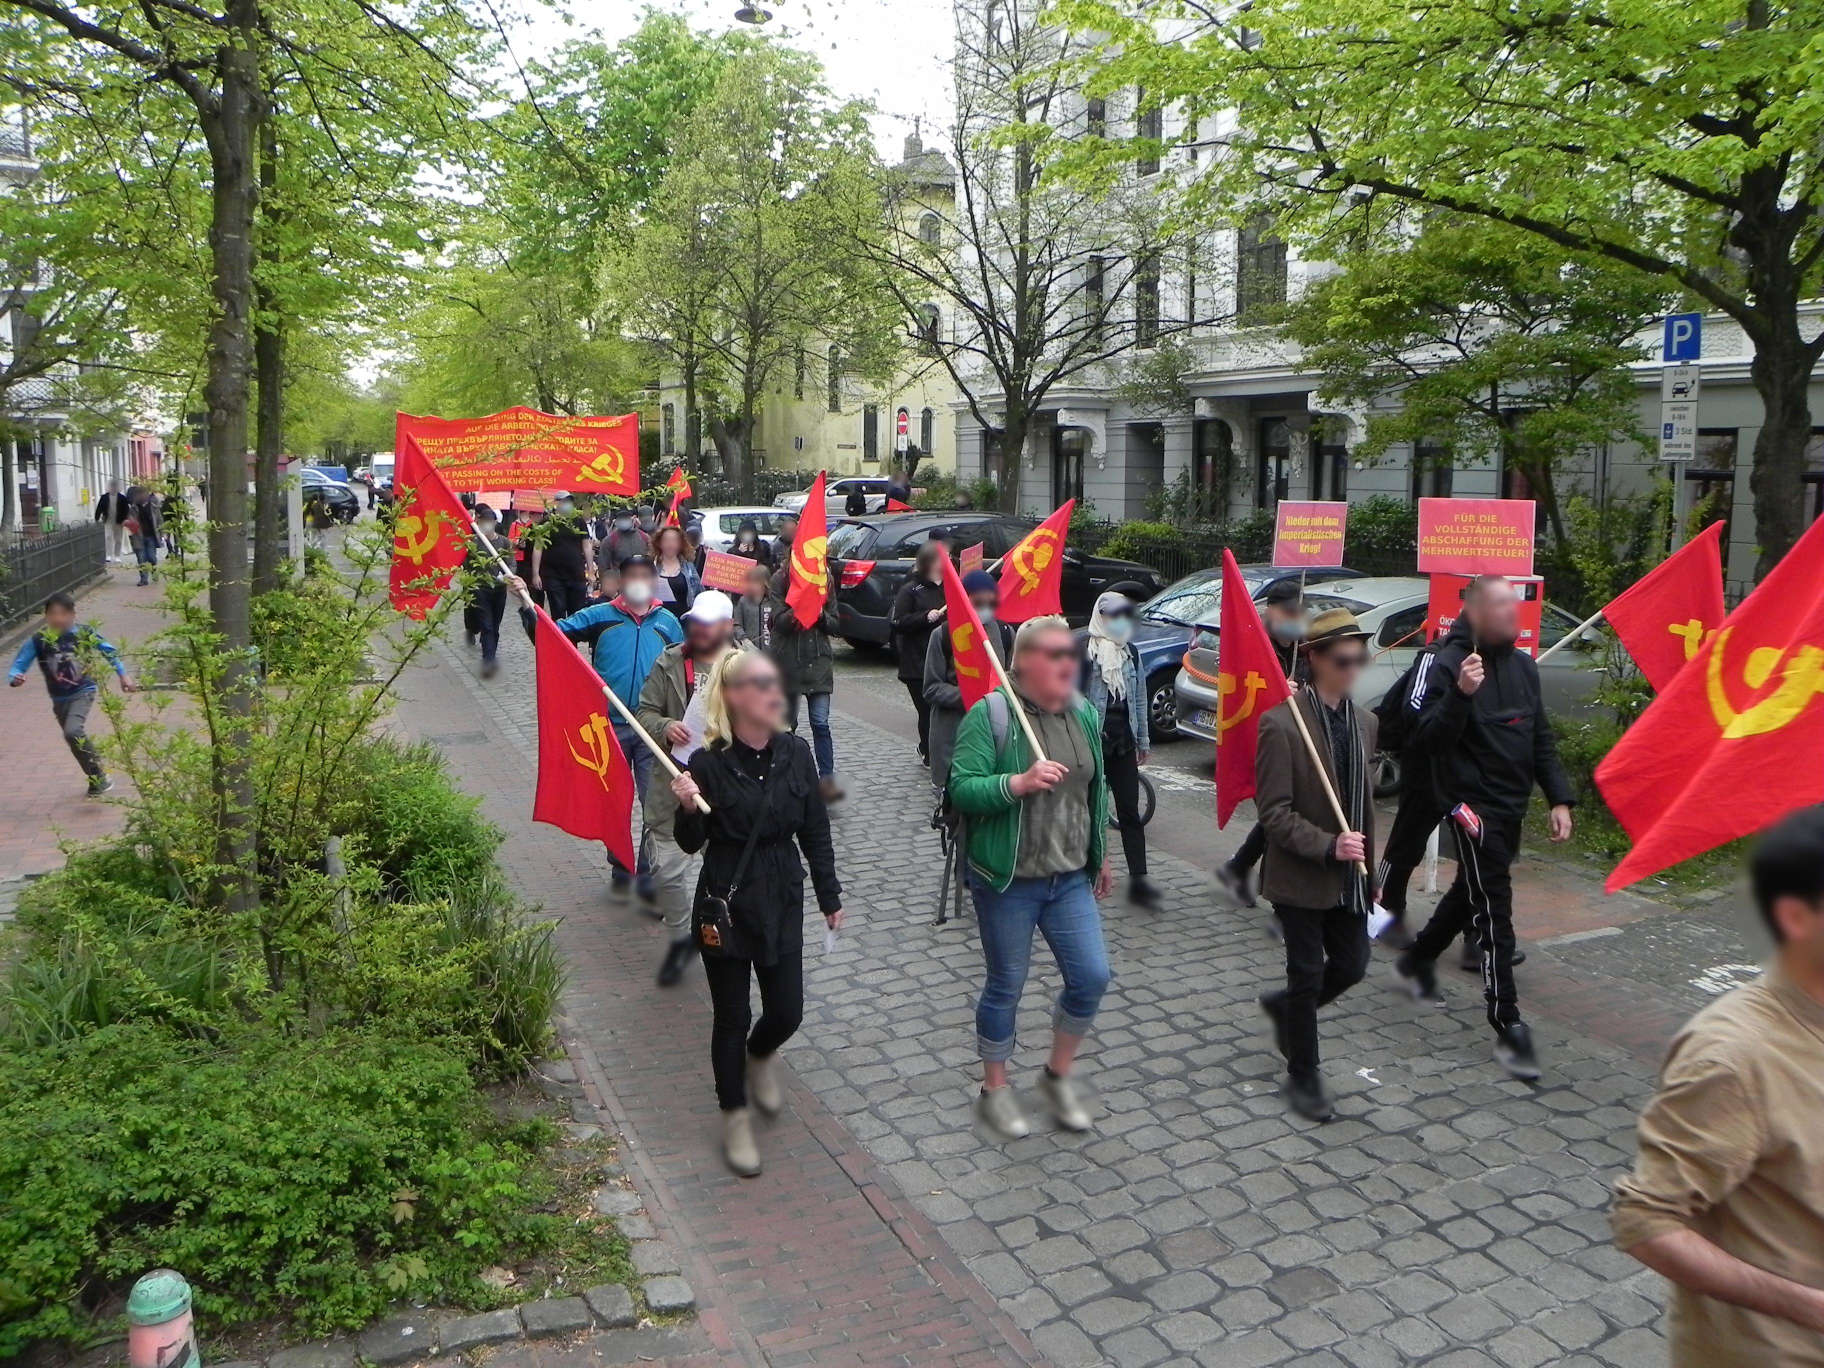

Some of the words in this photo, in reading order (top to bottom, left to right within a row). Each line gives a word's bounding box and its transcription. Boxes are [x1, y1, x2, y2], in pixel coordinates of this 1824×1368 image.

[1672, 320, 1693, 355] P
[452, 470, 488, 479] PASSING
[454, 479, 466, 487] TO
[486, 478, 526, 486] WORKING
[1285, 516, 1310, 526] Nieder
[1454, 512, 1476, 523] FÜR
[1479, 514, 1497, 523] DIE
[1434, 525, 1517, 535] VOLLSTÄNDIGE
[1422, 536, 1503, 546] ABSCHAFFUNG
[1507, 538, 1530, 546] DER
[1299, 543, 1321, 554] Krieg!
[1421, 546, 1529, 558] MEHRWERTSTEUER!
